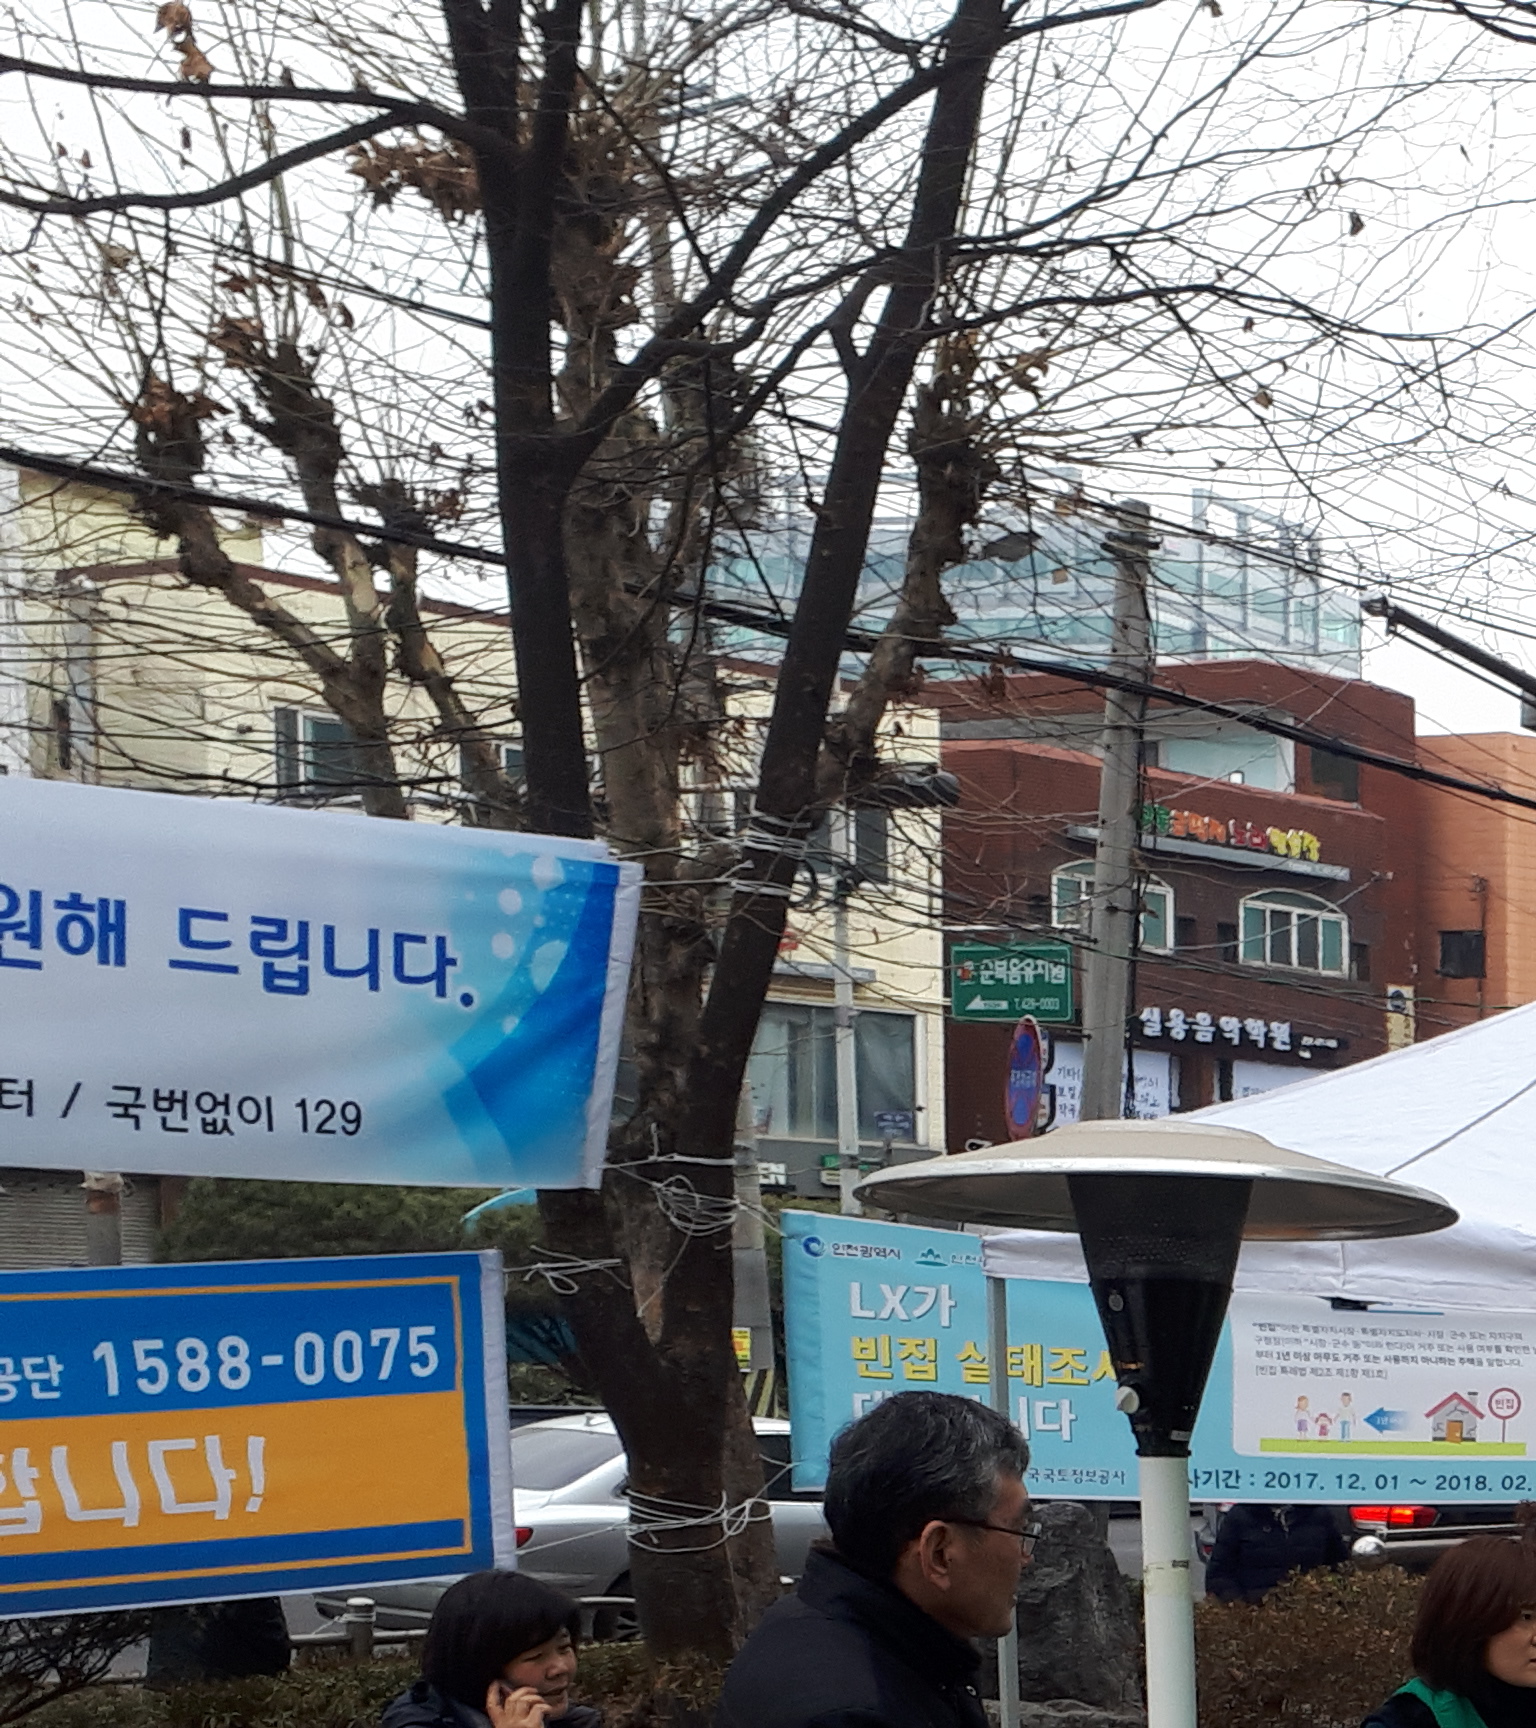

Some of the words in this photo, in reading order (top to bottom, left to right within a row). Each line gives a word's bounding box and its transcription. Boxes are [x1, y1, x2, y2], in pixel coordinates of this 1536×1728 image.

[169, 907, 478, 1008] 드립니다.
[1140, 1007, 1292, 1052] 실용음악학원
[105, 1085, 273, 1136] 국번없이
[295, 1099, 362, 1136] 129
[849, 1281, 957, 1329] LX가
[92, 1326, 440, 1397] 1588-0075
[851, 1335, 938, 1382] 빈집
[1264, 1471, 1325, 1491] 2017.
[1336, 1474, 1366, 1491] 12.
[1375, 1474, 1399, 1490] 01
[1435, 1474, 1493, 1492] 2018.
[1501, 1475, 1532, 1492] 02.
